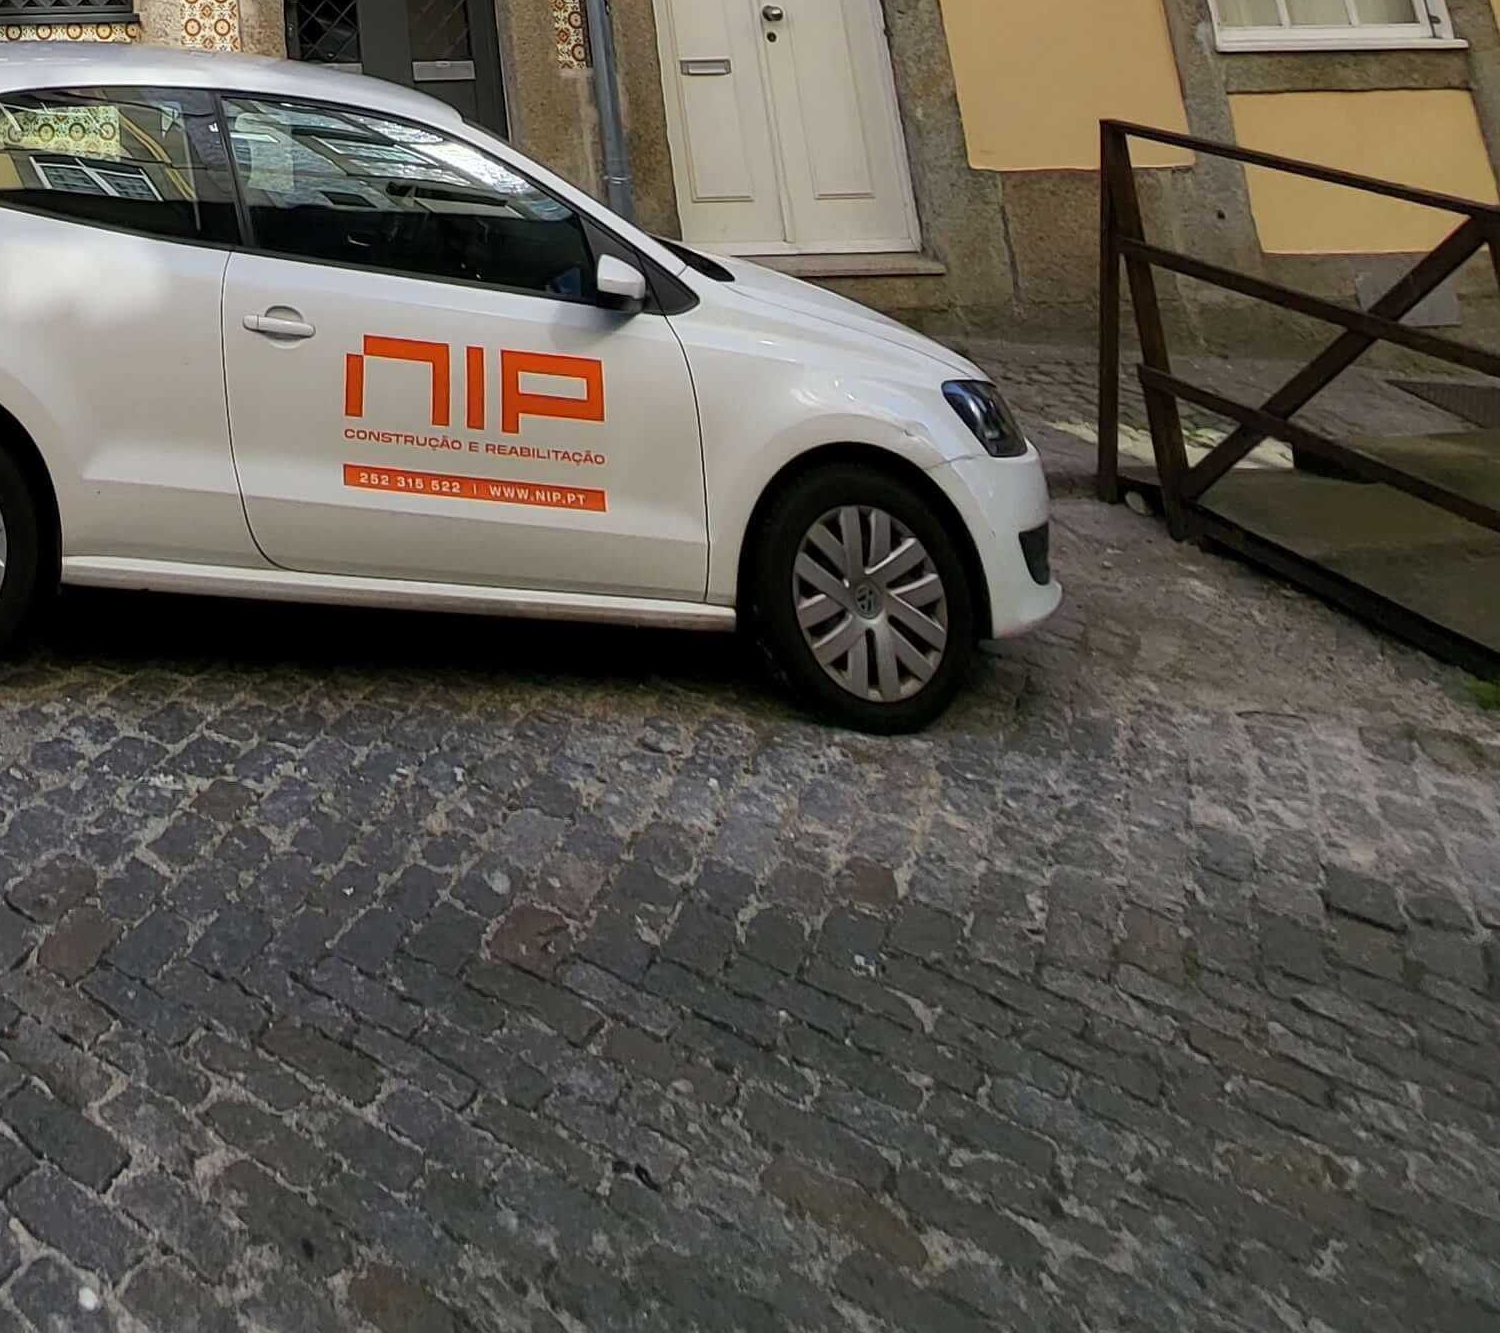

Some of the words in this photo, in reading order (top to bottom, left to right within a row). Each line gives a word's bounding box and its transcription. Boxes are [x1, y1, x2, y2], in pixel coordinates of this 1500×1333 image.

[344, 334, 605, 434] NIP
[344, 428, 462, 451] CONSTRUÇÃO
[468, 441, 479, 452] E
[485, 443, 605, 466] REABILITAÇÃO
[431, 480, 461, 493] 522
[489, 484, 586, 506] WWW.NIP.PT
